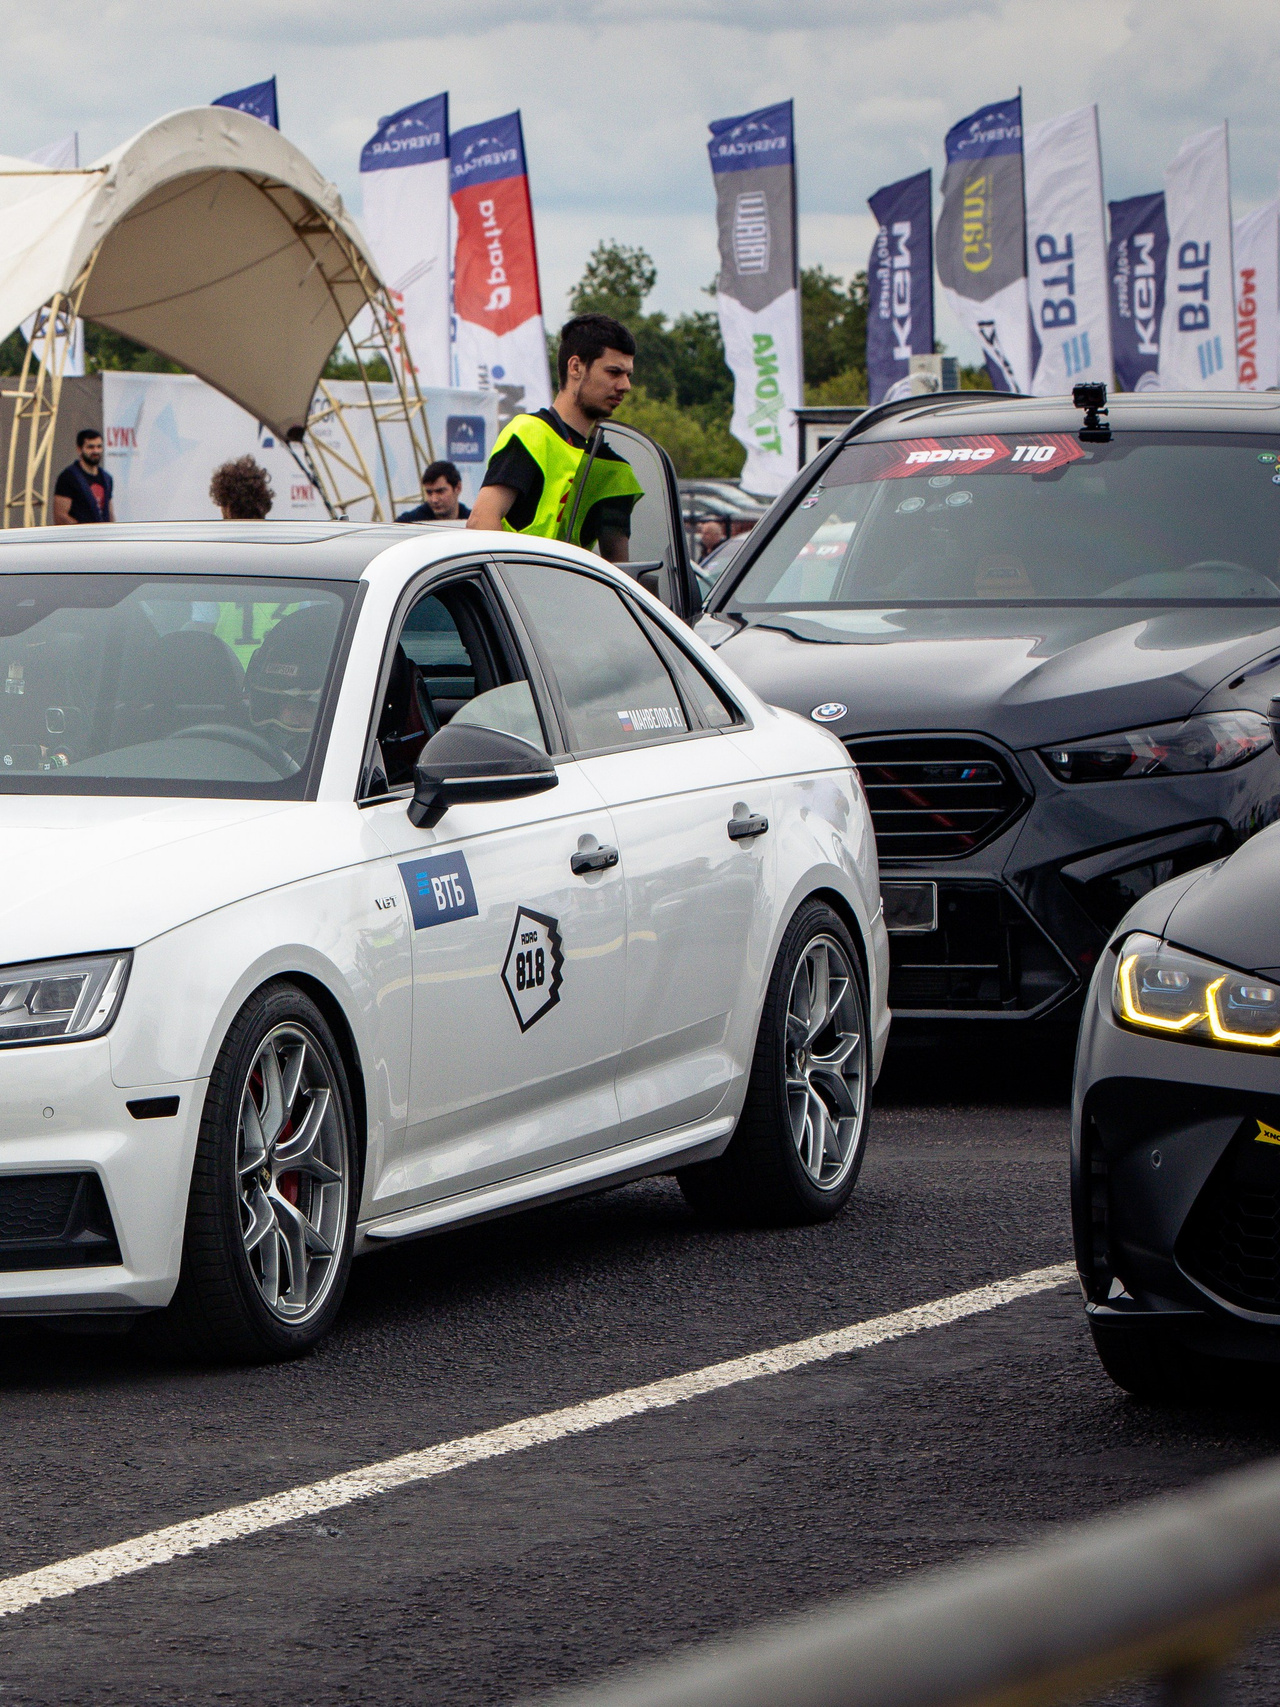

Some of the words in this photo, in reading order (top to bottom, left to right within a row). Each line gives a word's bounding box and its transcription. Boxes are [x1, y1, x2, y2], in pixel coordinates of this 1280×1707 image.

[905, 448, 995, 464] RDRC
[1011, 446, 1056, 462] 110
[431, 872, 466, 911] ВТБ
[521, 931, 538, 945] RDRC
[516, 947, 544, 991] 818
